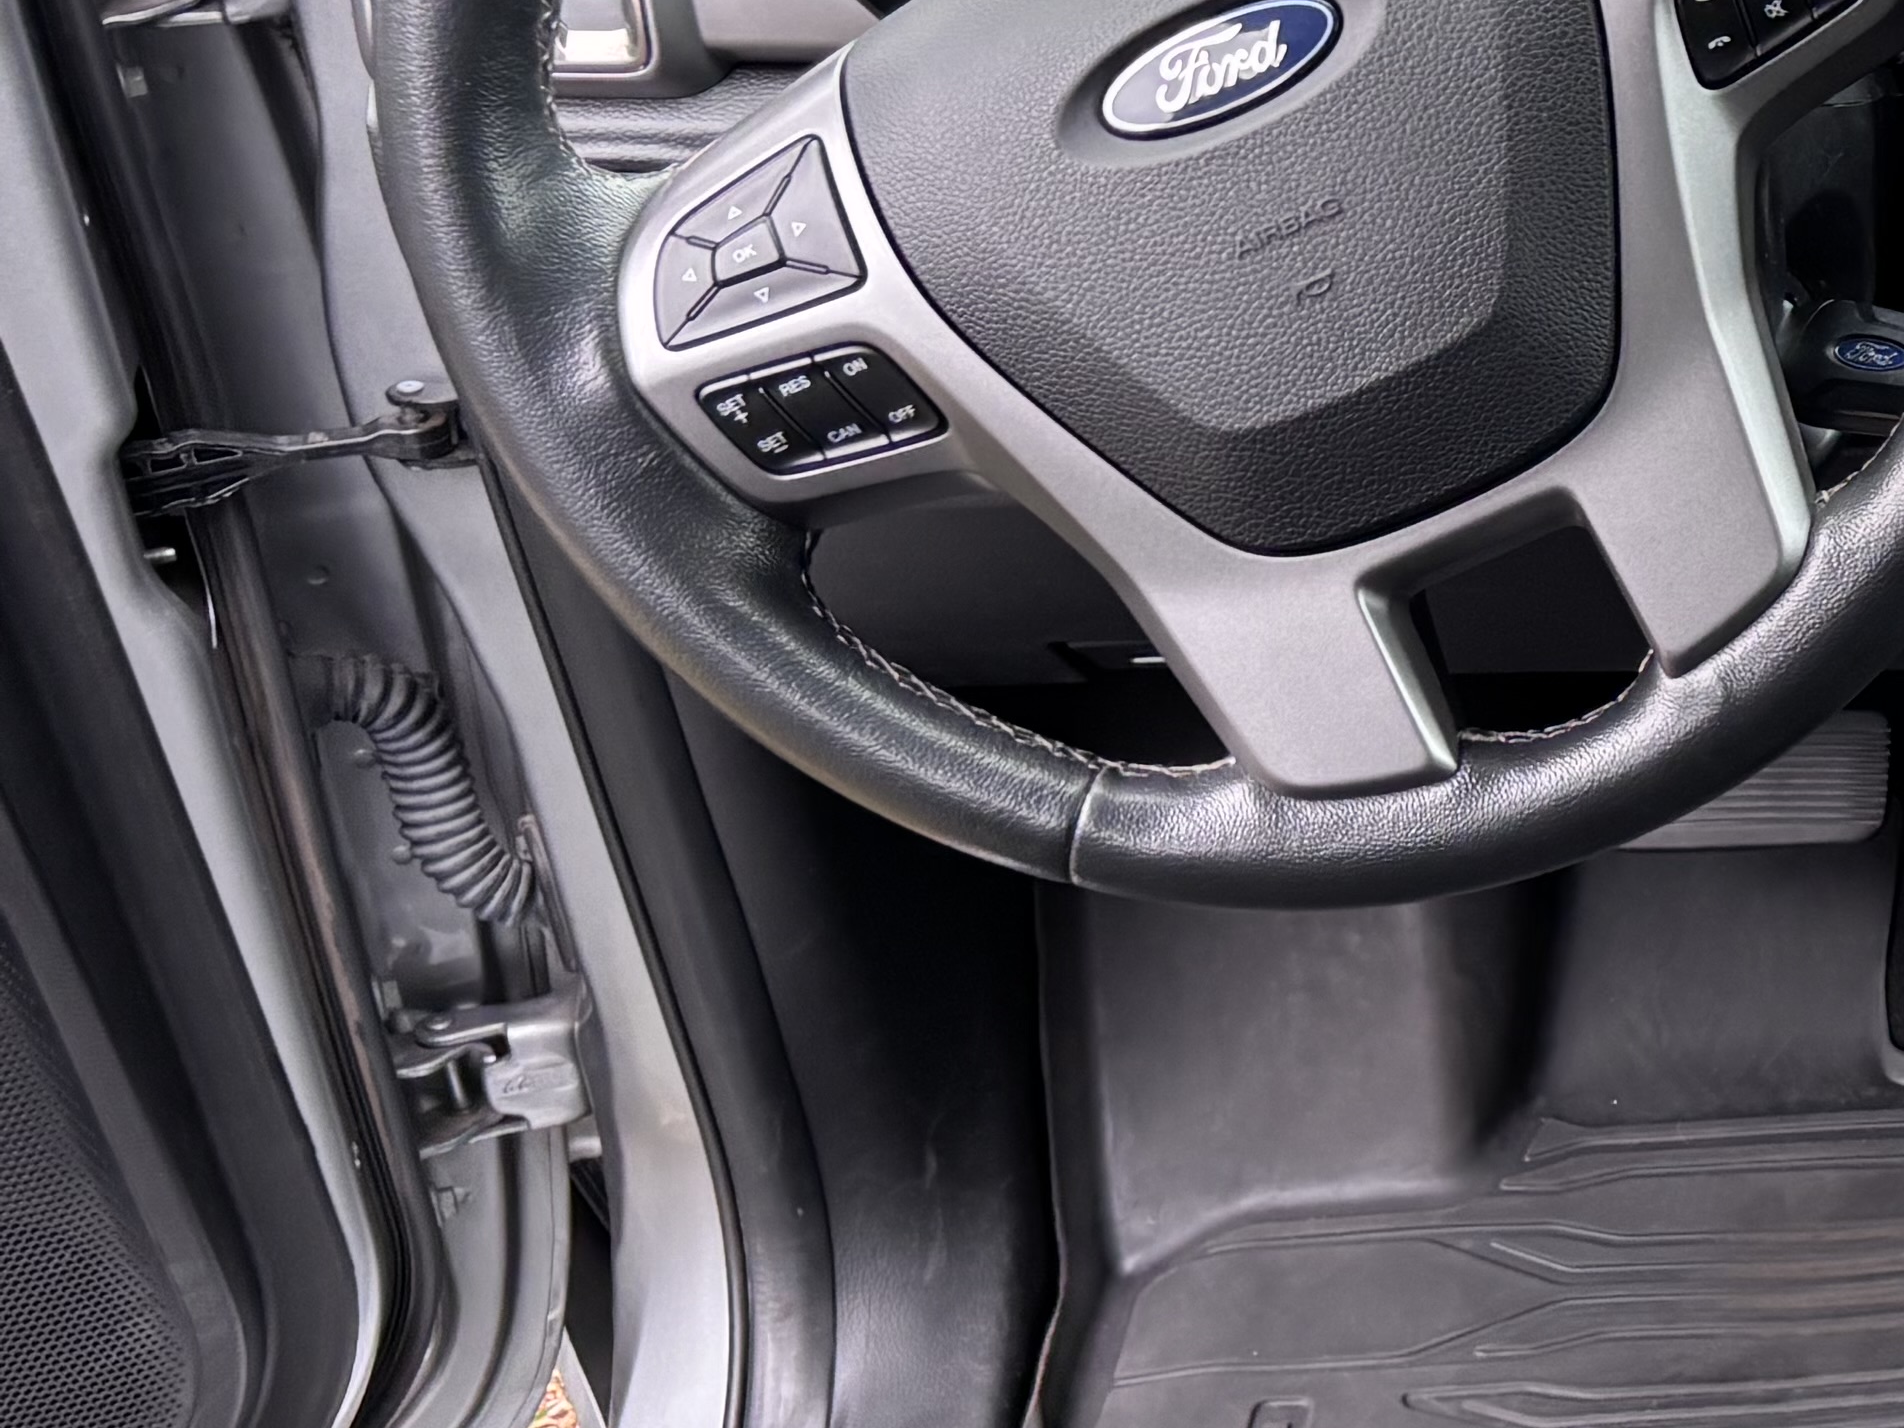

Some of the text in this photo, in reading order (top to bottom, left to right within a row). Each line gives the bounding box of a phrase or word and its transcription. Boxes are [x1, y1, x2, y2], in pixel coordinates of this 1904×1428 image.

[1155, 19, 1288, 113] Ford
[1235, 198, 1343, 259] AIRBAG
[732, 243, 758, 263] OK
[1845, 341, 1897, 367] Ford
[842, 357, 868, 377] ON
[778, 375, 811, 397] RES
[716, 394, 746, 417] SET
[888, 404, 917, 423] OFF
[757, 430, 787, 453] SET
[827, 423, 862, 443] CAN
